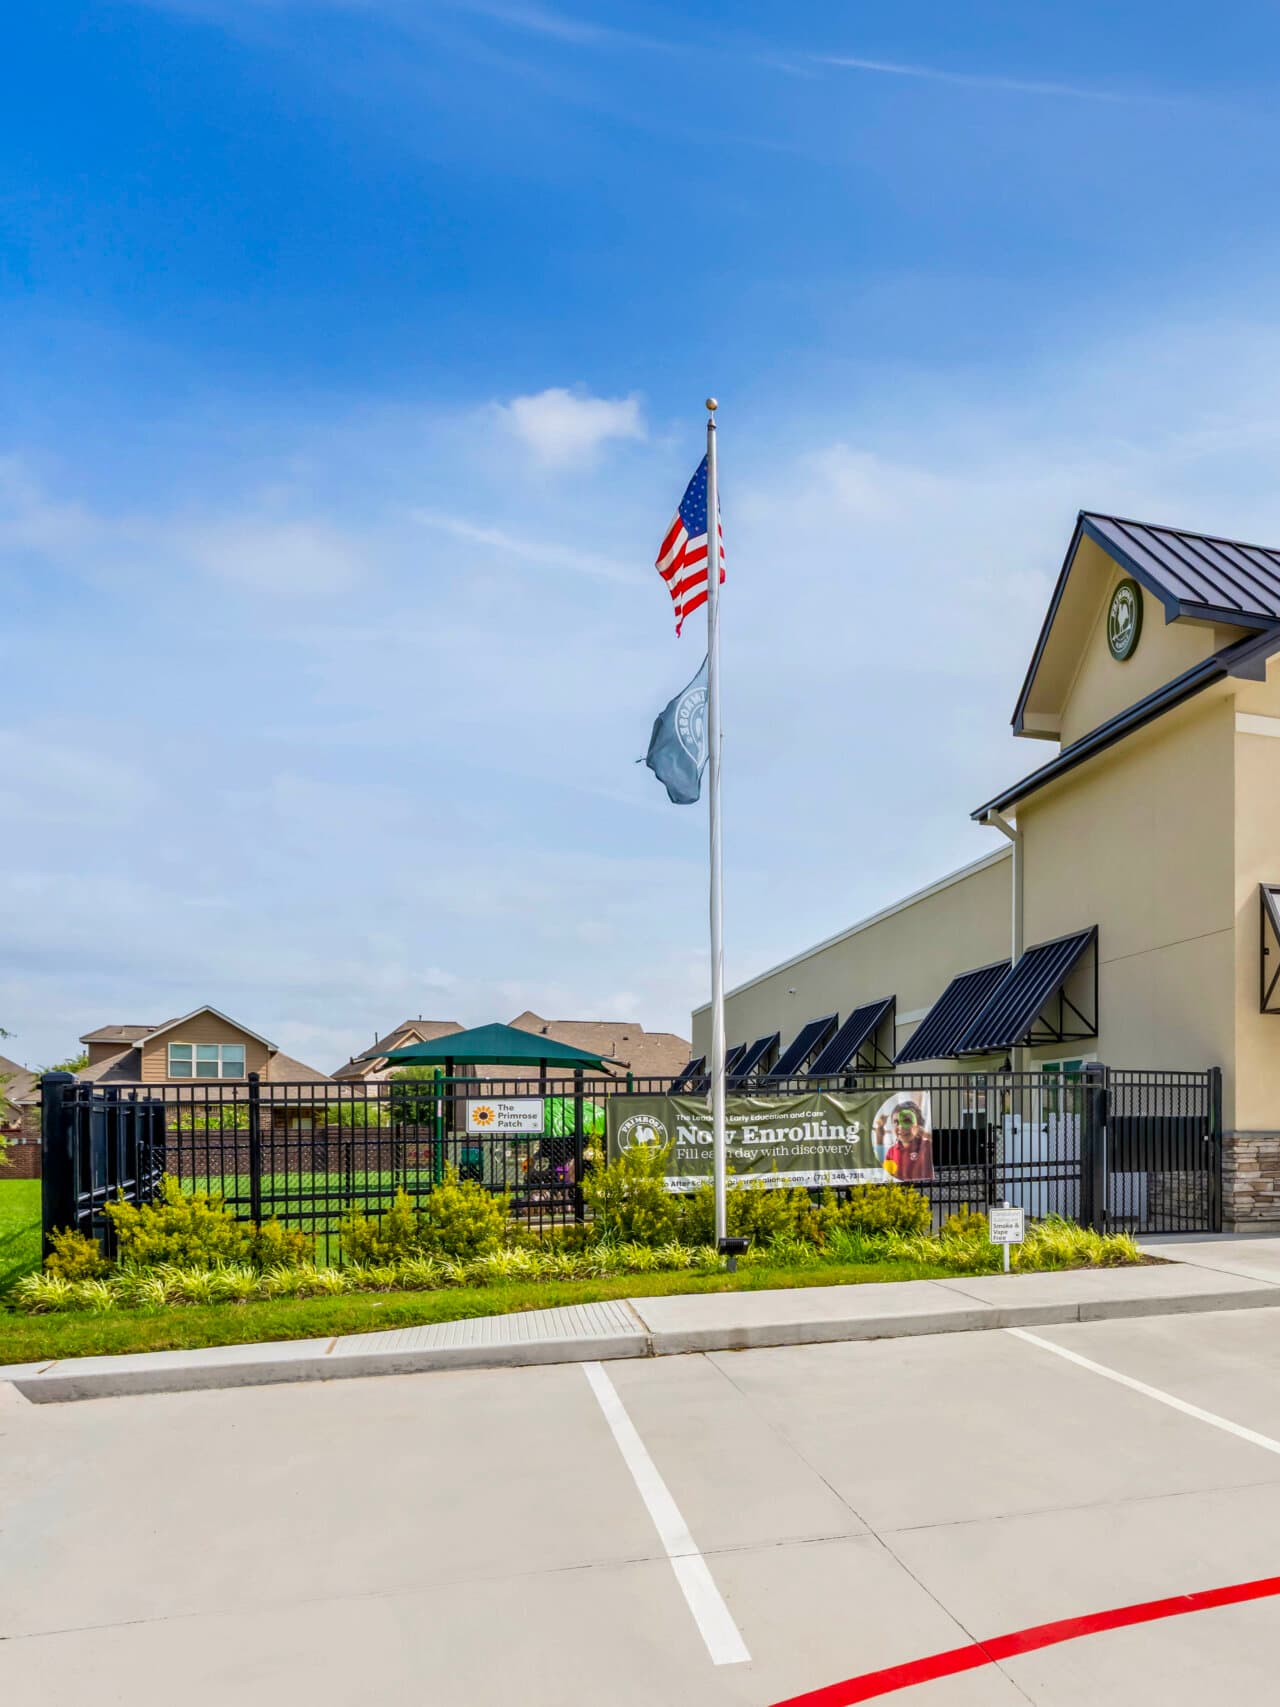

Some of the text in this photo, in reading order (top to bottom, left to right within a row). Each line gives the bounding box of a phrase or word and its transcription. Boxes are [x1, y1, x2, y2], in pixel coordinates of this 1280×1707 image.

[621, 1116, 664, 1134] PRIMROSE
[729, 1114, 749, 1123] Early
[750, 1112, 789, 1121] Education
[789, 1111, 805, 1119] and
[741, 1120, 860, 1144] Enrolling
[676, 1148, 698, 1160] Fill
[735, 1148, 757, 1160] day
[760, 1145, 789, 1157] with
[791, 1144, 854, 1156] discovery.
